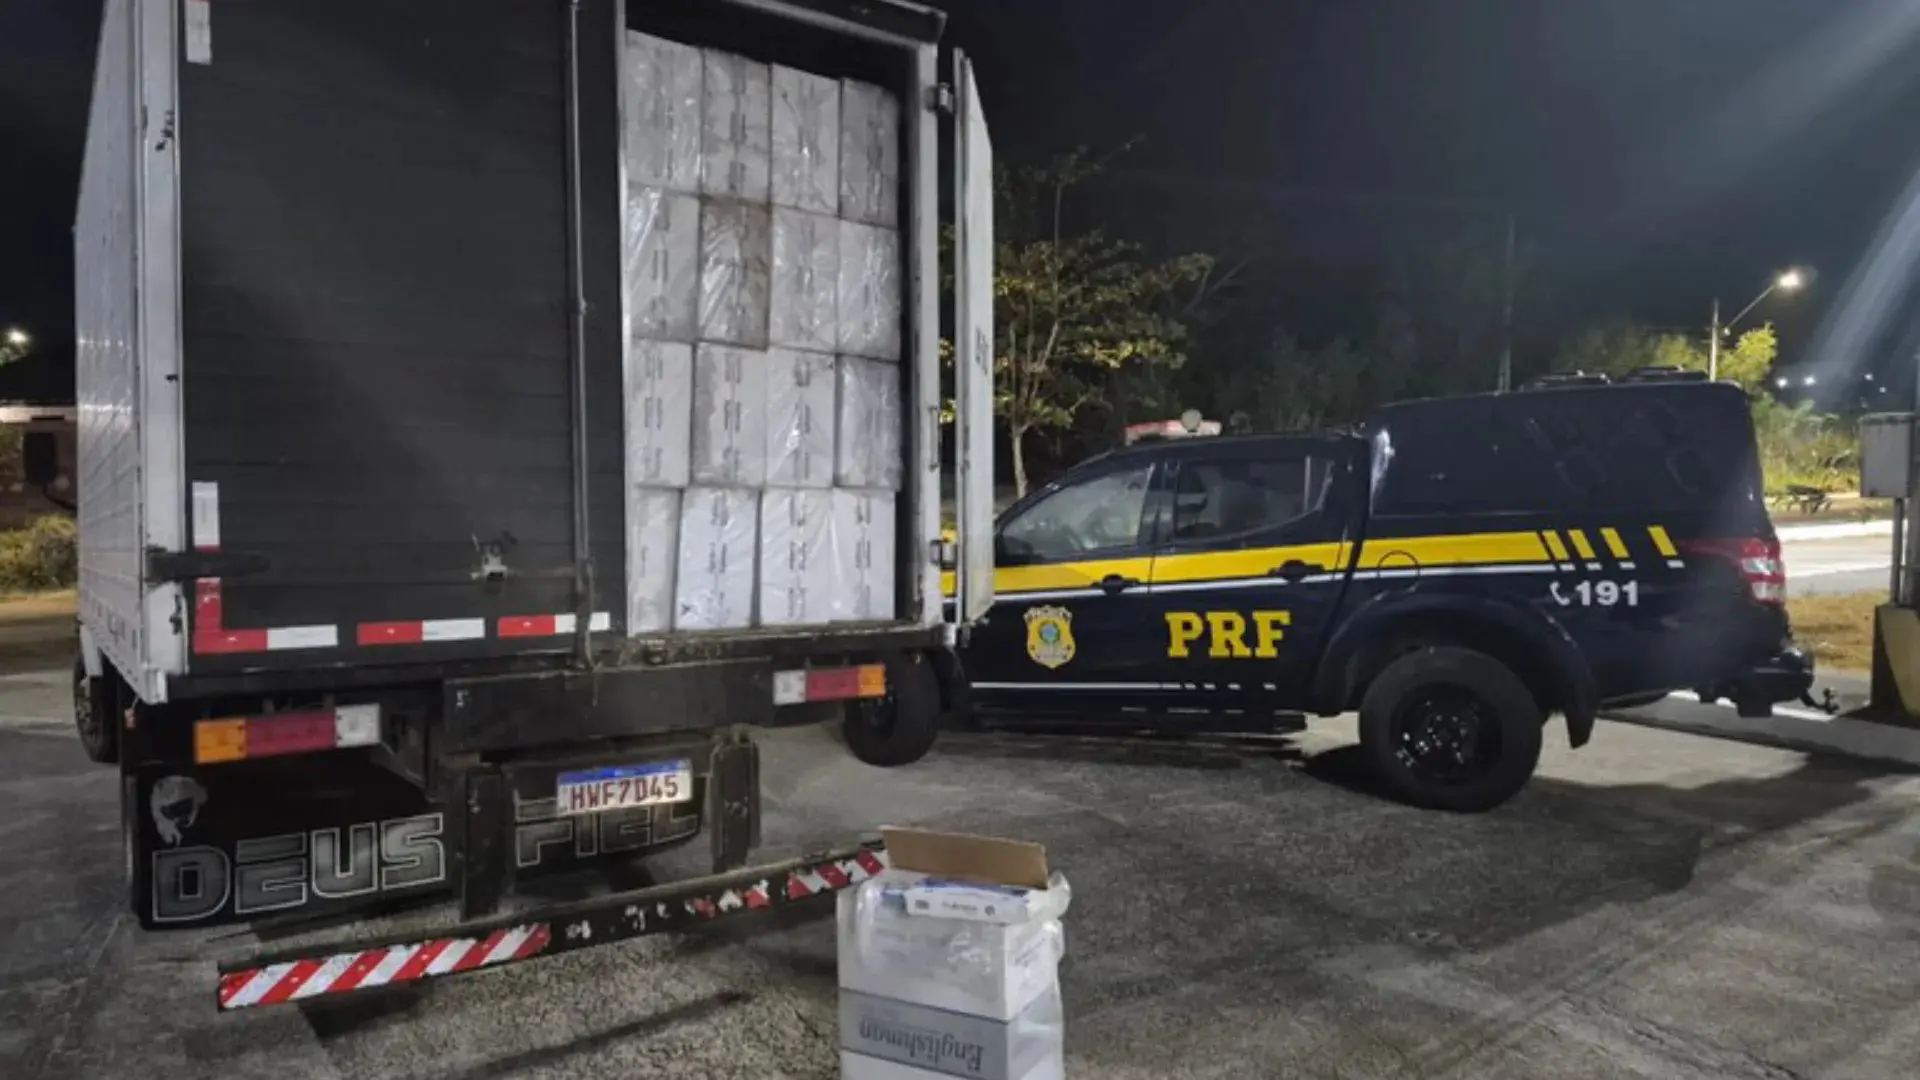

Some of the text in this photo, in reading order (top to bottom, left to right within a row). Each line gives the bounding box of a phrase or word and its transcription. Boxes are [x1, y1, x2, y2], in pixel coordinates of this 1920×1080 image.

[1574, 580, 1638, 606] 191
[1164, 610, 1292, 659] PRF
[571, 773, 679, 811] HWF7D45
[152, 812, 446, 922] DEUS
[859, 1017, 985, 1073] Englishman
